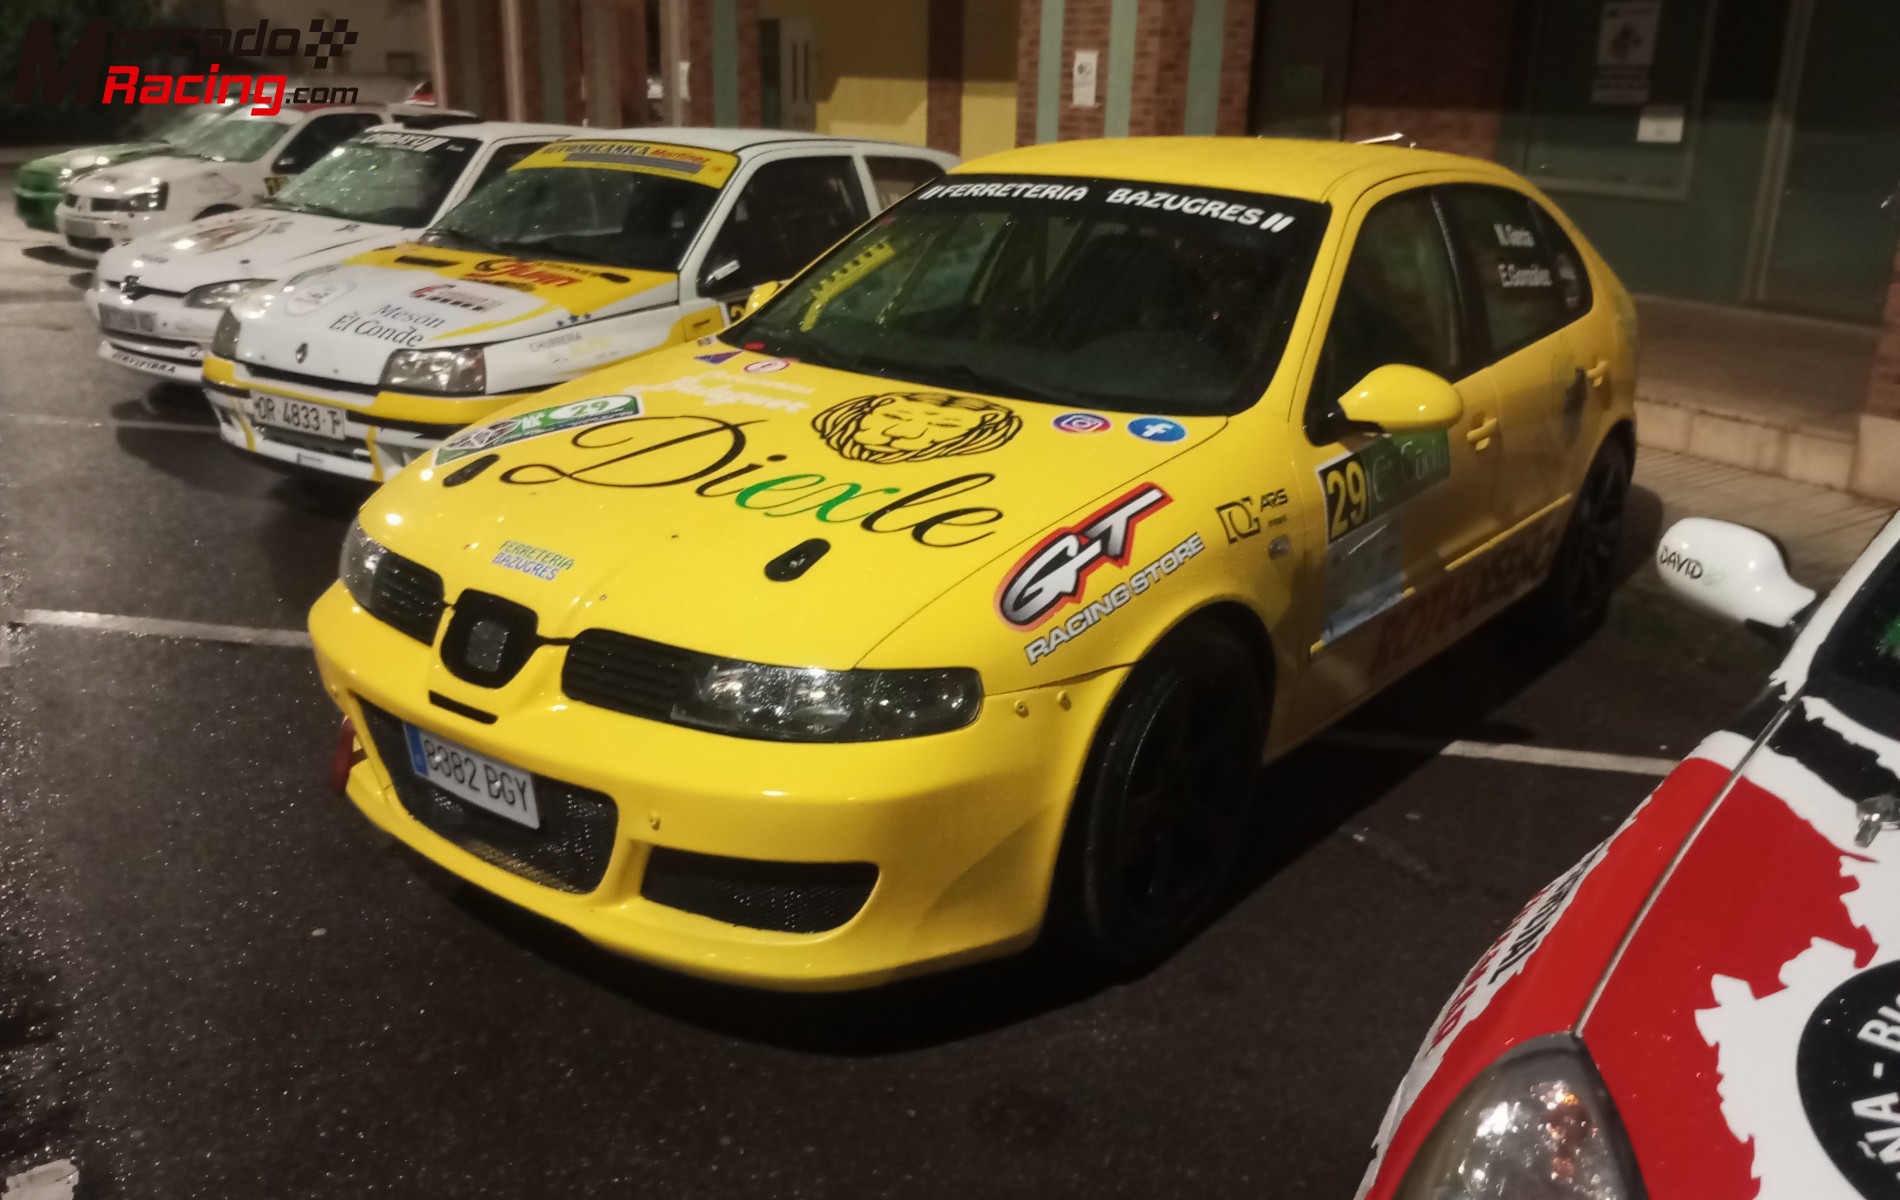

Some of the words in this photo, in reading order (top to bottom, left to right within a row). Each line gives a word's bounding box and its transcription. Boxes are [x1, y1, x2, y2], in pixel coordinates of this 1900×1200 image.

[937, 182, 1090, 201] FERRETERIA
[1105, 186, 1264, 227] BAZUGRES
[328, 313, 360, 332] El
[354, 319, 425, 348] Conde
[569, 400, 610, 417] 29
[498, 415, 1004, 549] Diexle
[1325, 460, 1368, 540] 29
[498, 539, 576, 571] FERRETERIA
[999, 485, 1168, 627] GT
[1024, 582, 1133, 666] RACING
[1129, 531, 1206, 597] STORE
